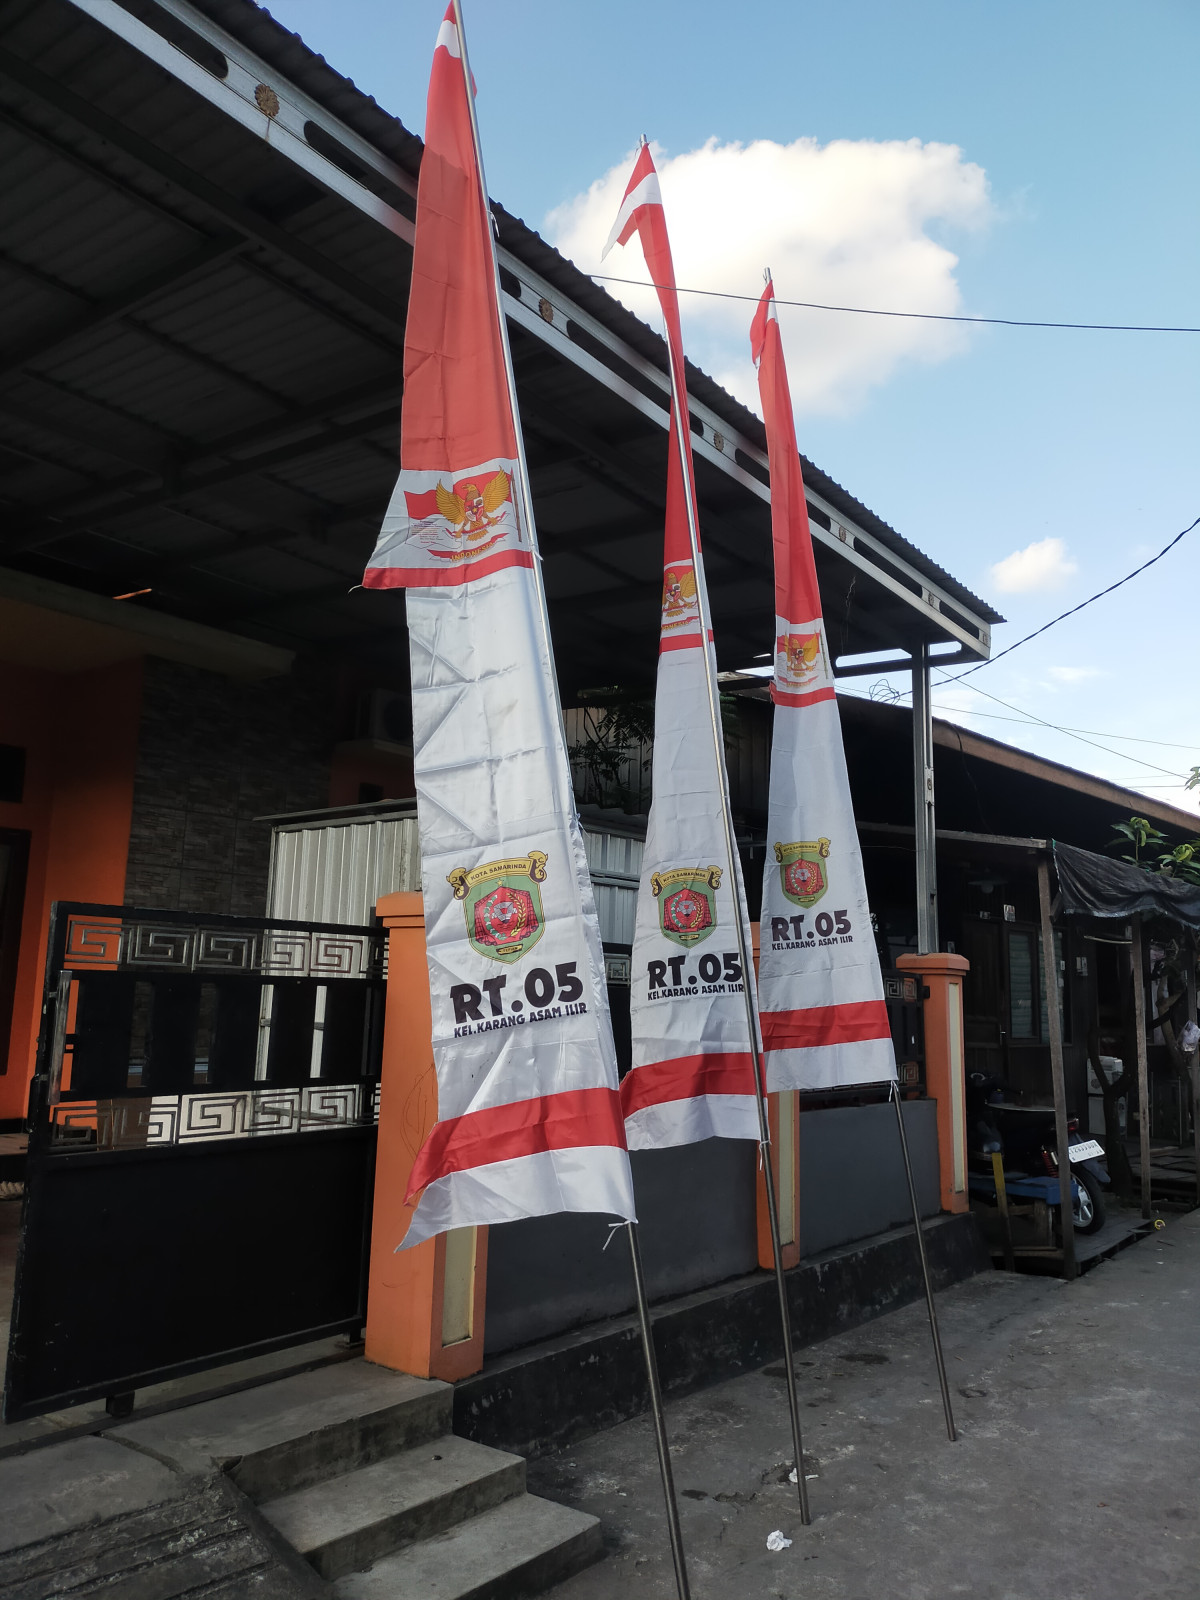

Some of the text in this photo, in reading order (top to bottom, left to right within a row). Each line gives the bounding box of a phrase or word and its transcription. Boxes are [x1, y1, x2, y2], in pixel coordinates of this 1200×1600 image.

[470, 863, 527, 881] KOTA SAMARINDA
[771, 909, 852, 942] RT.05
[772, 935, 854, 951] KEL.KARANG ASAM ILIR
[647, 953, 743, 990] RT.05
[450, 961, 584, 1025] RT.05
[647, 983, 745, 1001] KEL.KARANG ASAM ILIR
[453, 1002, 588, 1038] KEL.KARANG ASAM ILIR
